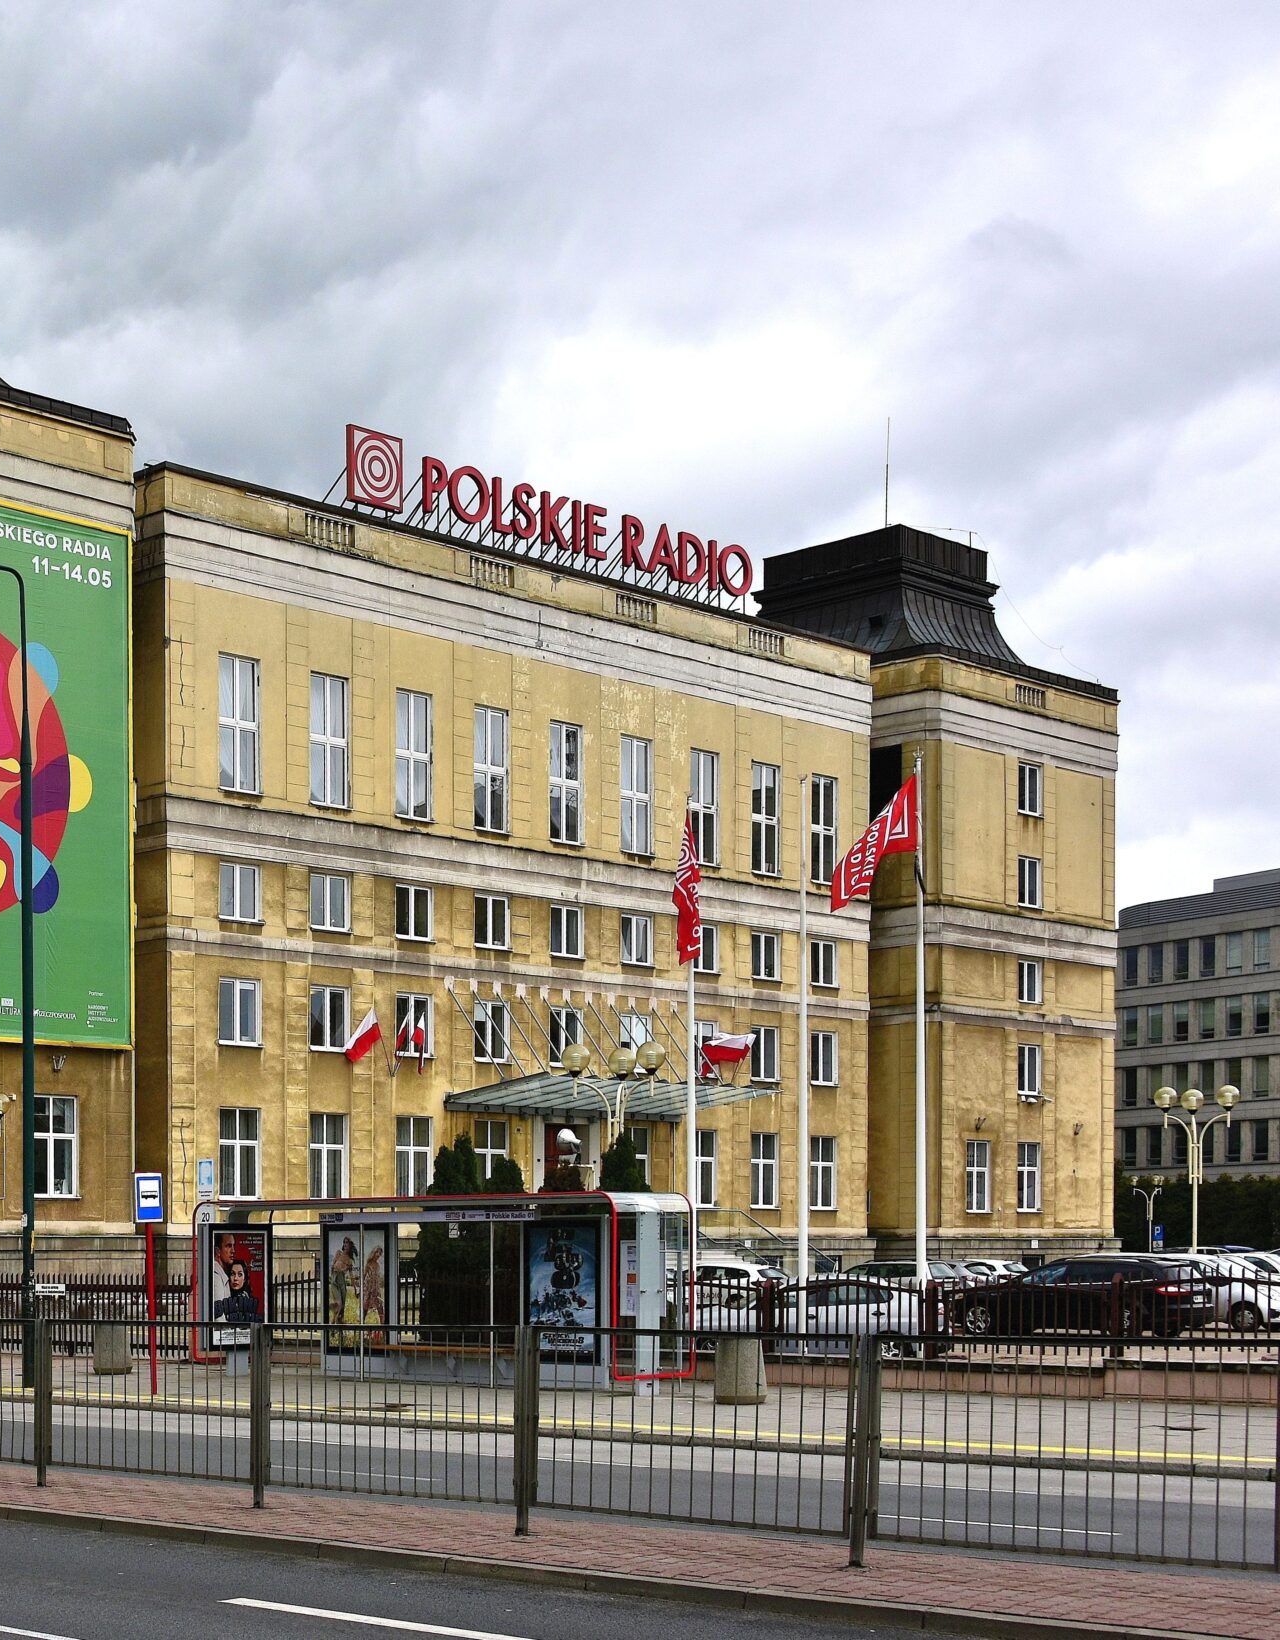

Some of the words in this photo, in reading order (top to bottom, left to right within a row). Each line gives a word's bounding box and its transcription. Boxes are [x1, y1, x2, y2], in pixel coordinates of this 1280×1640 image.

[422, 456, 608, 561] POLSKIE
[621, 514, 754, 597] RADIO
[62, 537, 112, 562] RADIA
[862, 823, 881, 878] POLSKIE
[1154, 1226, 1161, 1236] P
